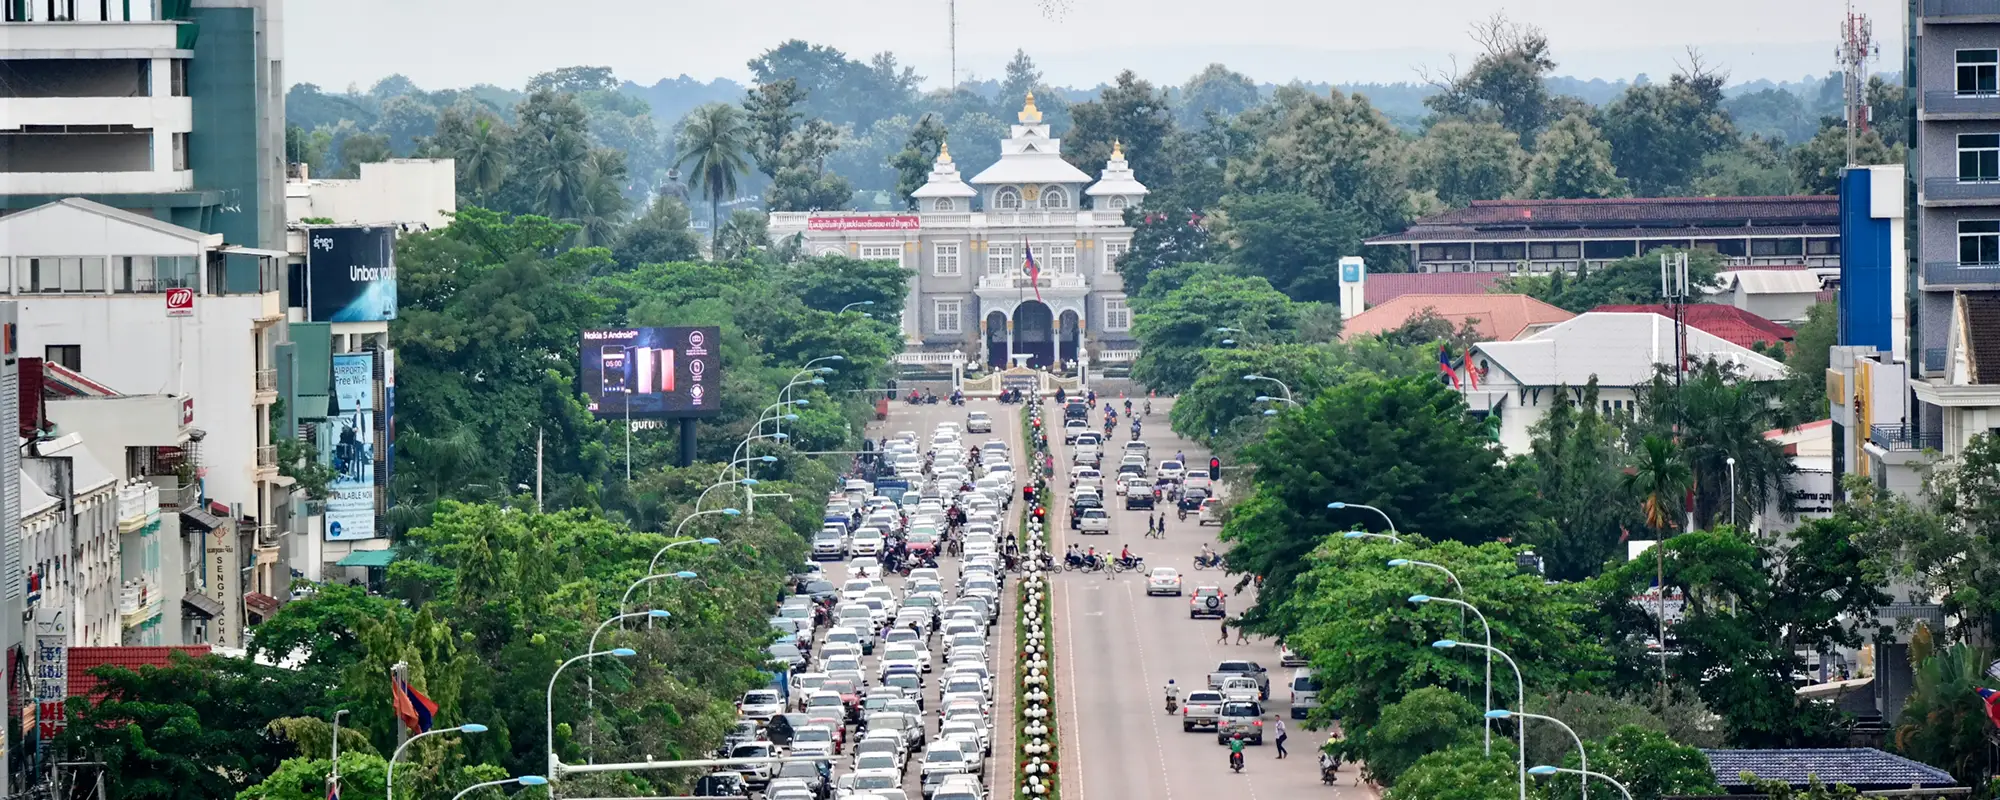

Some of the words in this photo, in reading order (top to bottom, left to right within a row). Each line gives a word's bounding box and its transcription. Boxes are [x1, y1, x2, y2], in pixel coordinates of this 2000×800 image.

[350, 265, 379, 281] Unbox
[584, 331, 603, 339] Nokia
[603, 331, 608, 339] 5
[334, 366, 361, 375] AIRPORT
[335, 375, 352, 386] Free
[331, 491, 361, 500] VAILABLE
